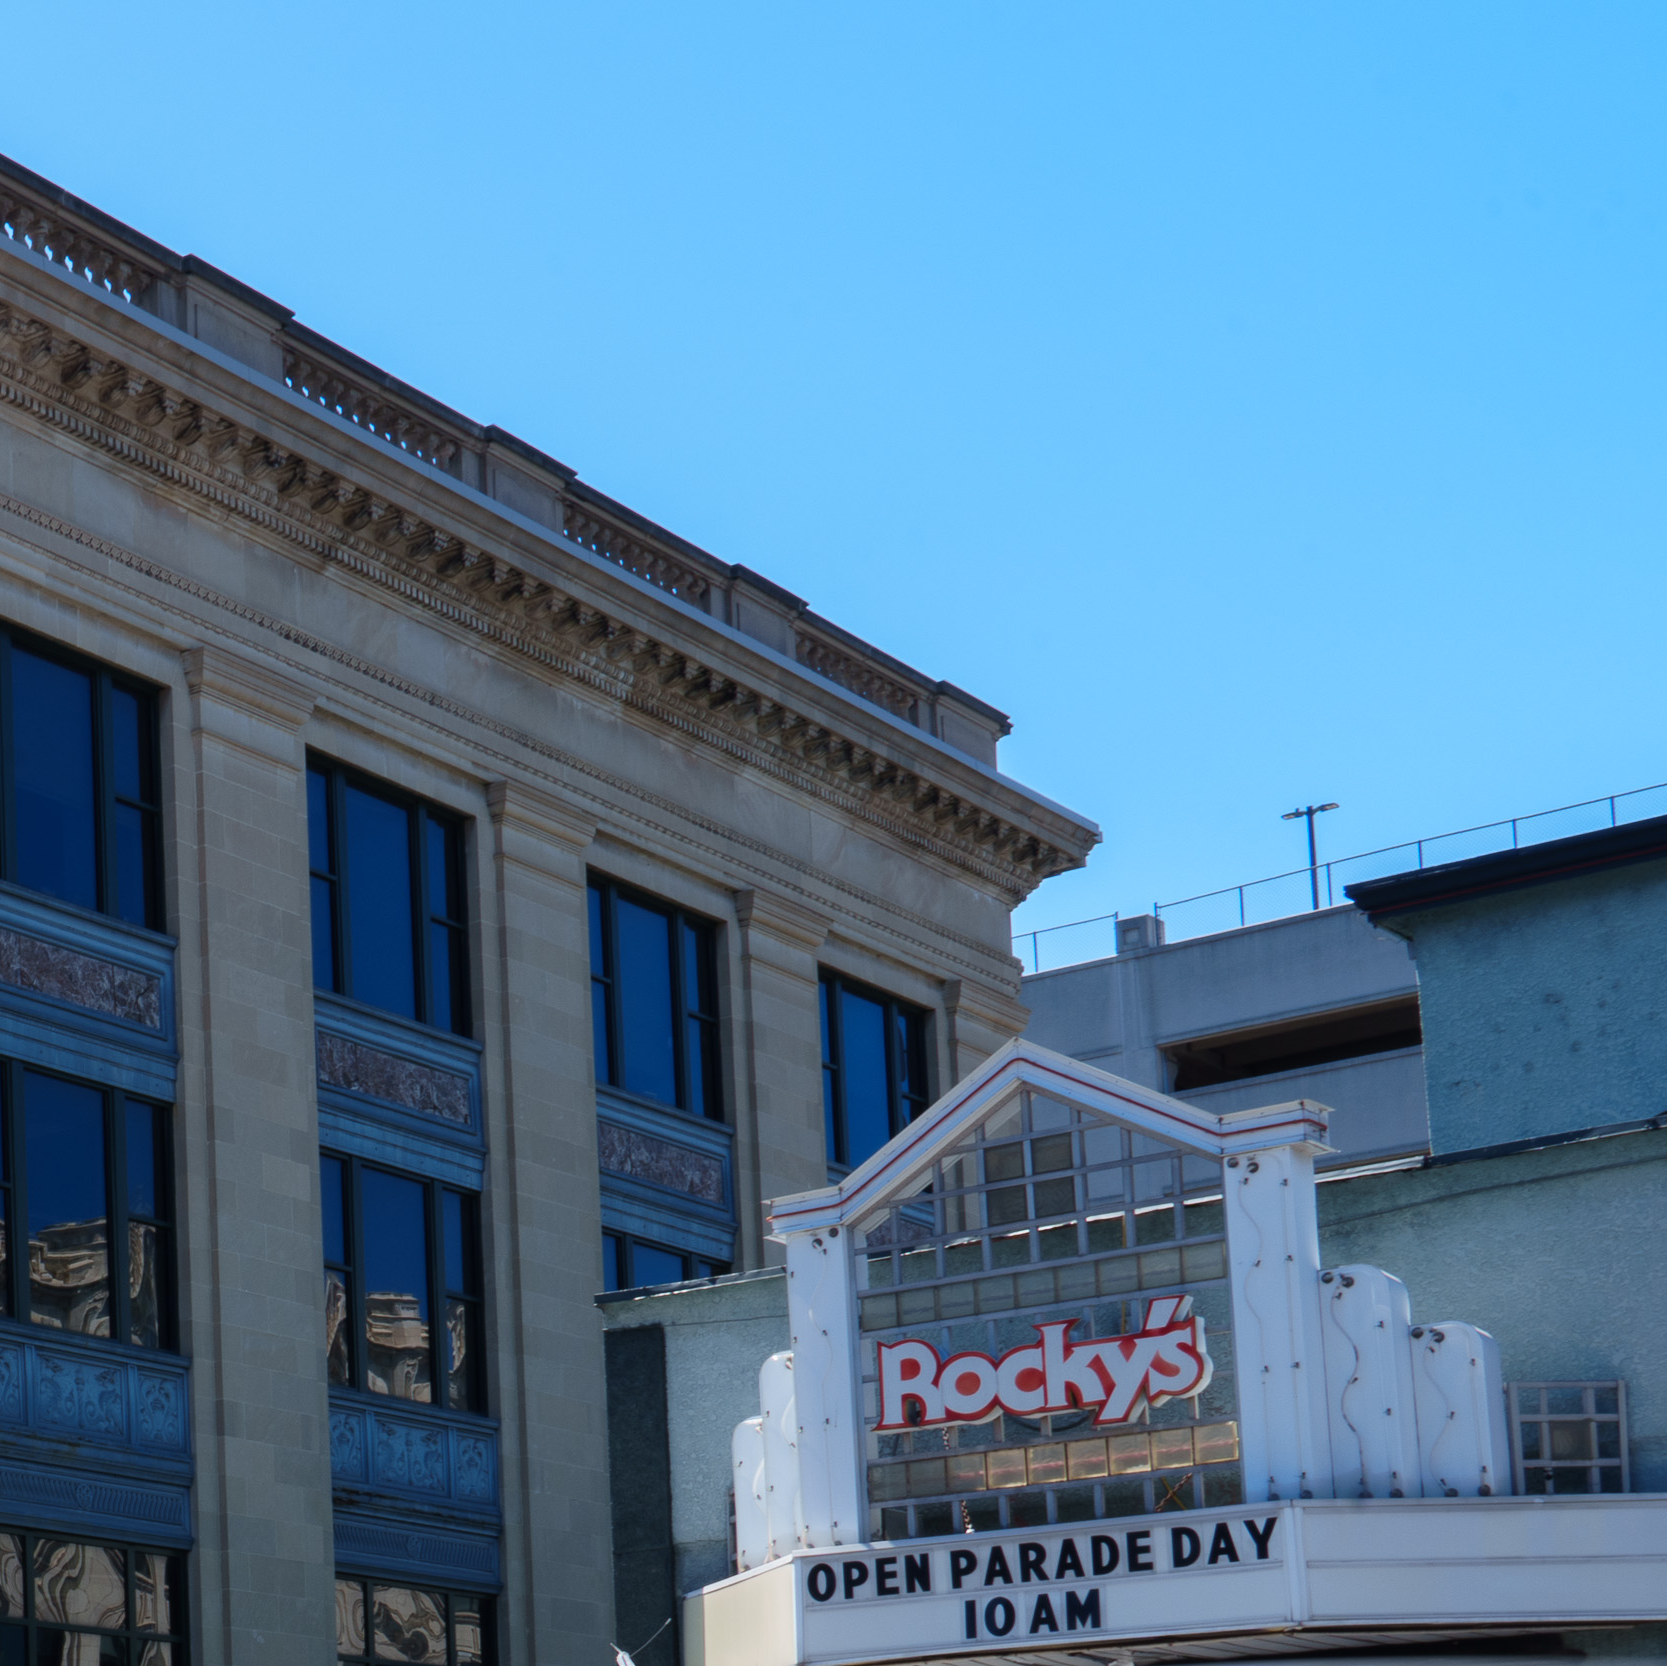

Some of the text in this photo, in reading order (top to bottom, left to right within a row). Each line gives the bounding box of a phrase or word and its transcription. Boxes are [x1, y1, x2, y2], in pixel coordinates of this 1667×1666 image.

[872, 1294, 1212, 1434] Rocky's
[807, 1516, 1278, 1602] OPEN PARADE DAY
